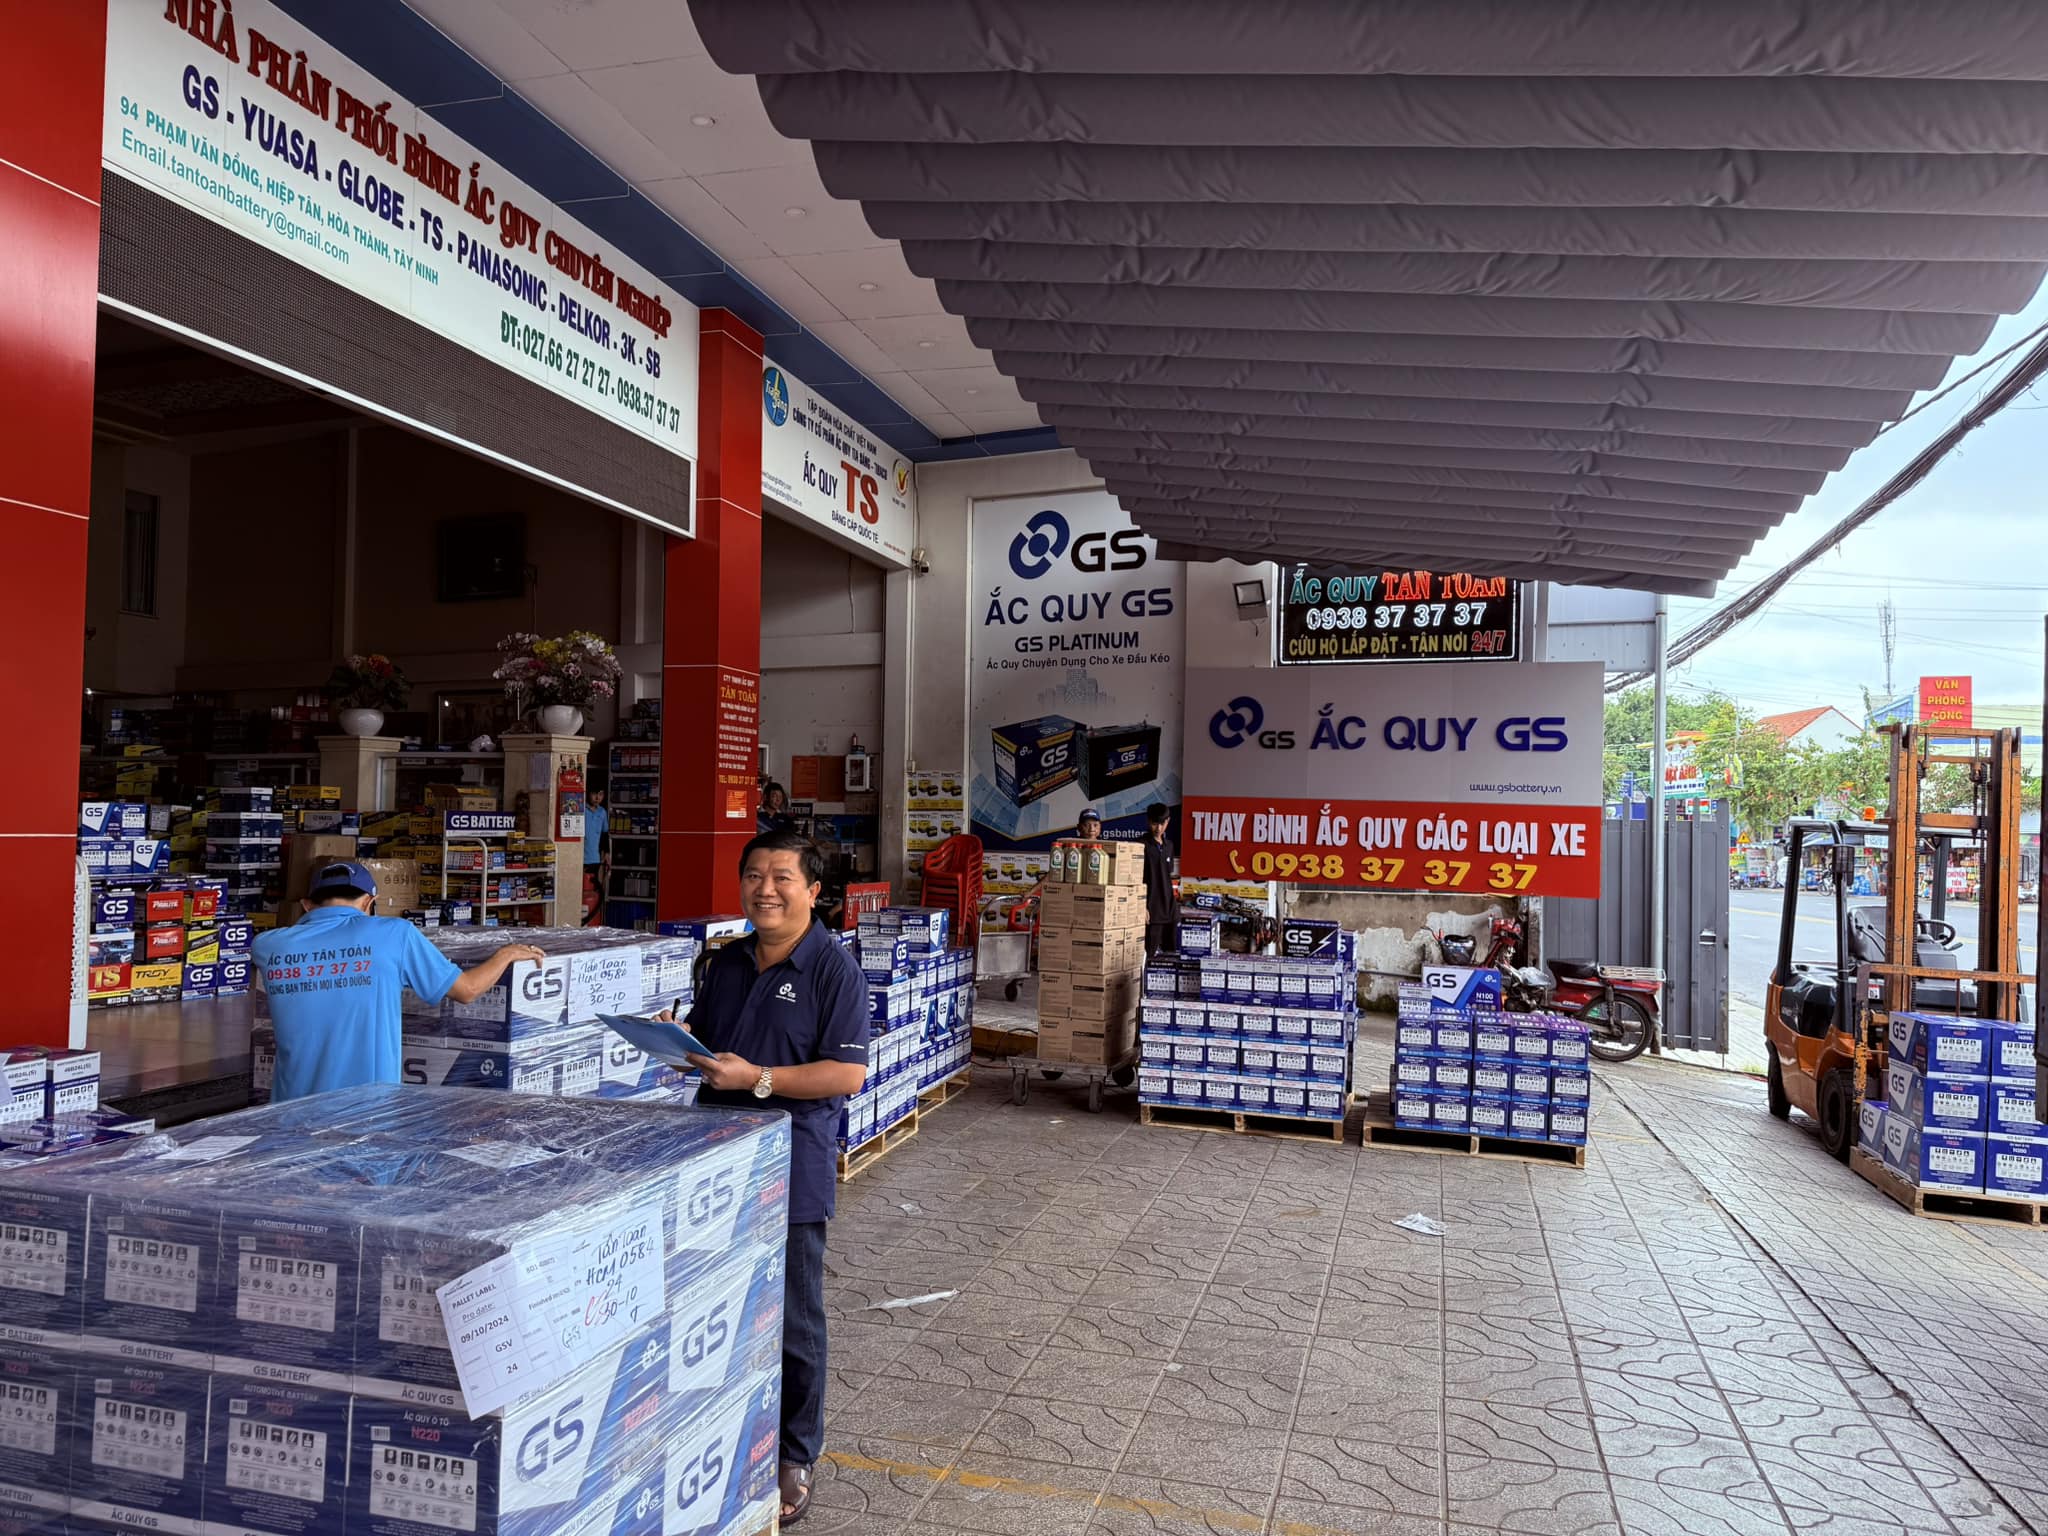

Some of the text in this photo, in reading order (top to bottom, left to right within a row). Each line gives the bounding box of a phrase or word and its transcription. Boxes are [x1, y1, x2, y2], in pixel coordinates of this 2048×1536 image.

[164, 0, 672, 340] NHÀ PHÂN PHỐI BÌNH ẮC QUY CHUYÊN NGHIỆP
[120, 96, 438, 285] 94 PHẠM VĂN ĐỒNG, HIỆP TÂN, HÒA THÀNH, TÂY NINH
[122, 127, 350, 264] Email.tantoanbattery@gmail.com
[182, 64, 661, 379] GS YUASA GLOBE TS PANASONIC DELKOR 3K SB
[566, 348, 579, 381] 27
[582, 357, 595, 389] 27
[597, 366, 610, 397] 27
[617, 376, 654, 420] 0938.37
[656, 399, 667, 427] 37
[669, 406, 680, 434] 37
[807, 418, 815, 433] TY
[803, 450, 816, 488] ẮC
[818, 468, 838, 500] QUY
[840, 460, 879, 525] TS
[1071, 529, 1147, 573] GS
[1289, 568, 1378, 605] ẮC QUY
[984, 586, 1174, 626] ẮC QUY GS
[1306, 602, 1487, 630] 0938 37 37 37
[1014, 631, 1140, 653] GS PLATINUM
[1289, 629, 1506, 660] CỨU HỘ LẮP ĐẶT TẬN NƠI 24/7
[1001, 656, 1019, 671] Quy
[1022, 654, 1058, 670] Chuyên
[1089, 654, 1110, 667] Cho
[1111, 654, 1124, 666] Xe
[1150, 651, 1170, 665] Kéo
[720, 685, 757, 704] TÂN TOÀN
[1258, 703, 1568, 752] GS ẮC QUY GS
[1040, 743, 1069, 768] GS
[1120, 751, 1136, 762] GS
[1469, 781, 1562, 795] www.gsbattery.vn
[85, 807, 103, 817] GS
[450, 815, 516, 829] GS BATTERY
[1191, 803, 1586, 860] THAY BÌNH ẮC QUY CÁC LOẠI XE
[136, 844, 153, 854] GS
[1251, 850, 1538, 890] 0938 37 37 37
[103, 900, 129, 915] GS
[1196, 896, 1214, 907] GS
[225, 927, 248, 941] GS
[1285, 929, 1313, 944] GS
[284, 944, 371, 965] QUY TÂN TOÀN
[91, 967, 121, 988] TS
[135, 968, 169, 979] TROY
[190, 967, 213, 982] GS
[224, 963, 246, 978] GS
[267, 960, 371, 981] 0938 37 37 37
[1426, 973, 1457, 988] GS
[299, 978, 318, 993] TRÊN
[522, 967, 563, 1001] GS
[1475, 992, 1493, 1000] N100
[1892, 1020, 1907, 1041] GS
[1891, 1073, 1905, 1095] GS
[1861, 1108, 1874, 1128] GS
[1887, 1126, 1902, 1147] GS
[687, 1165, 734, 1227] GS
[160, 1206, 192, 1218] BATTERY
[295, 1222, 329, 1235] BATTERY
[452, 1293, 475, 1309] PALLET
[475, 1283, 497, 1297] LABEL
[7, 1328, 44, 1344] BATTERY
[460, 1315, 509, 1344] 09/10/2024
[682, 1300, 728, 1368] GS
[120, 1344, 174, 1362] GS BATTERY
[495, 1339, 513, 1353] GSV
[253, 1365, 311, 1384] GS BATTERY
[506, 1363, 518, 1375] 24
[286, 1389, 318, 1402] BATTERY
[417, 1390, 440, 1404] QUY
[438, 1394, 455, 1406] GS
[415, 1413, 431, 1425] QUY
[411, 1426, 440, 1442] N220
[516, 1395, 584, 1483] GS
[677, 1436, 724, 1510] GS
[125, 1511, 144, 1526] QUY
[144, 1516, 158, 1528] GS
